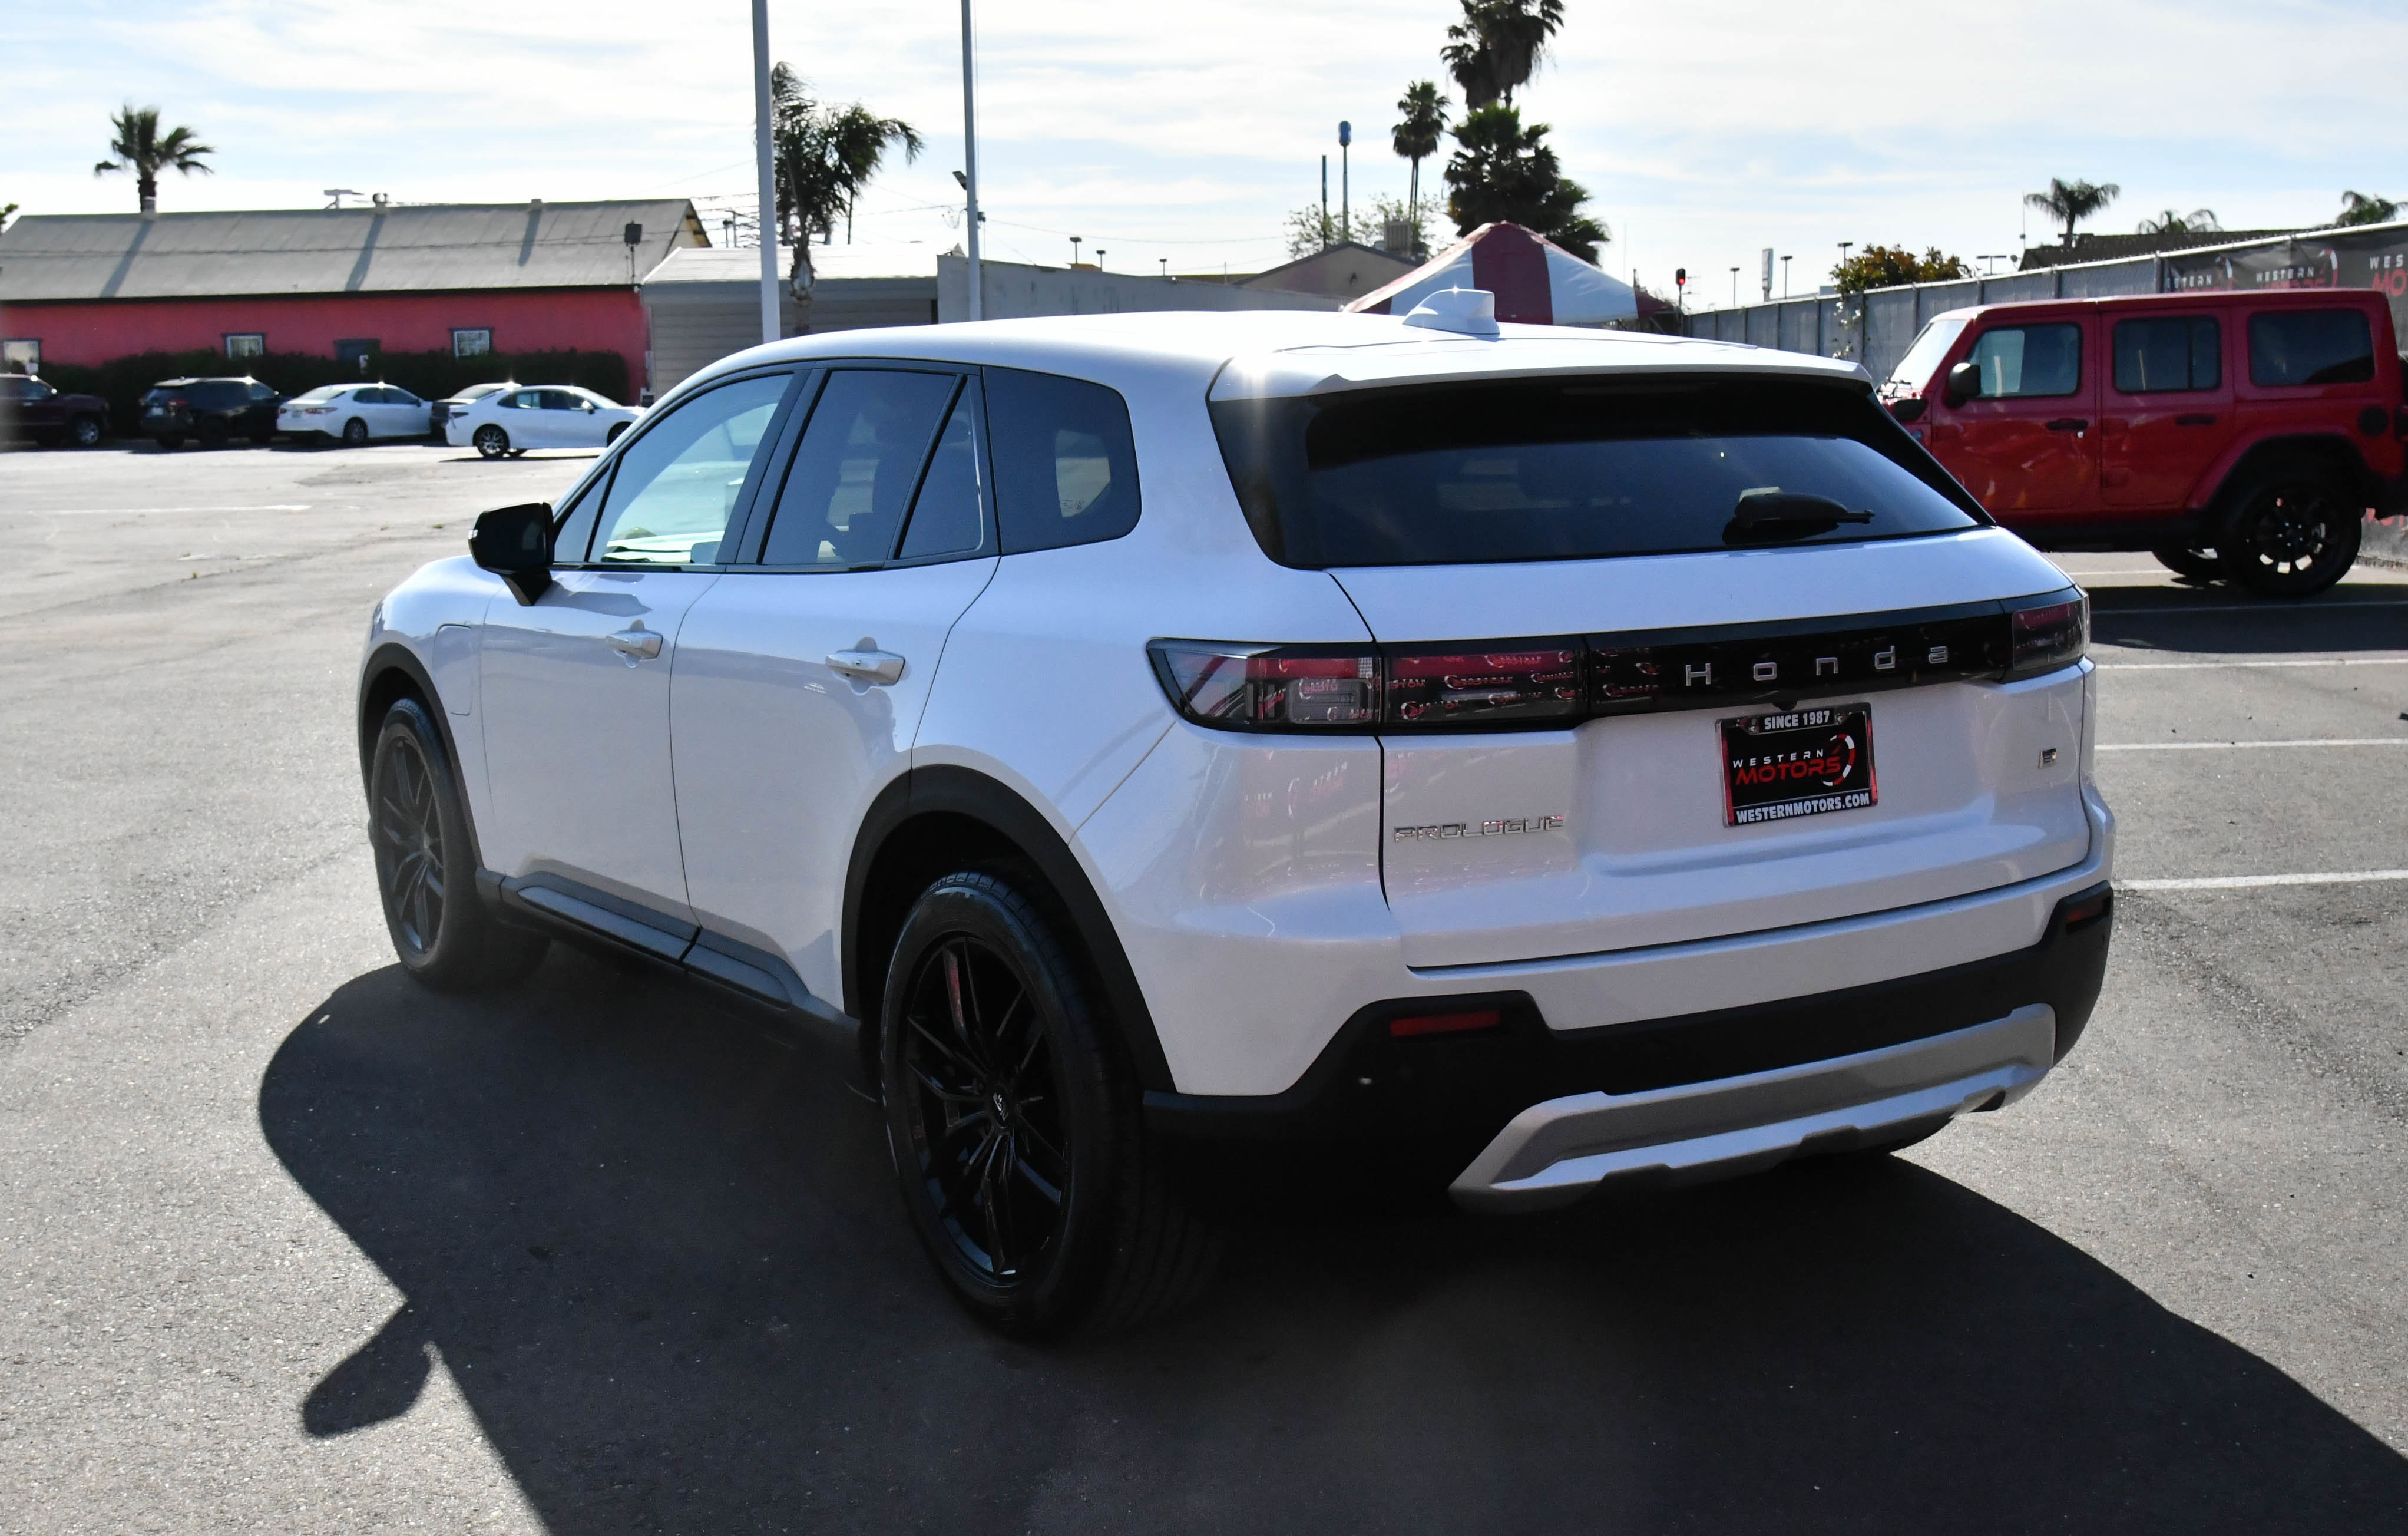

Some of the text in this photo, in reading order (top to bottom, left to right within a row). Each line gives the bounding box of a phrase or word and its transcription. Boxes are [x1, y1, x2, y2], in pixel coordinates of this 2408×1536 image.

[1764, 710, 1830, 730] SINCE 1987
[1732, 749, 1824, 768] WESTERN
[1735, 756, 1842, 786] MOTORS
[1736, 792, 1870, 824] WESTERNMOTORS.COM
[1394, 814, 1564, 843] PROLOGUE
